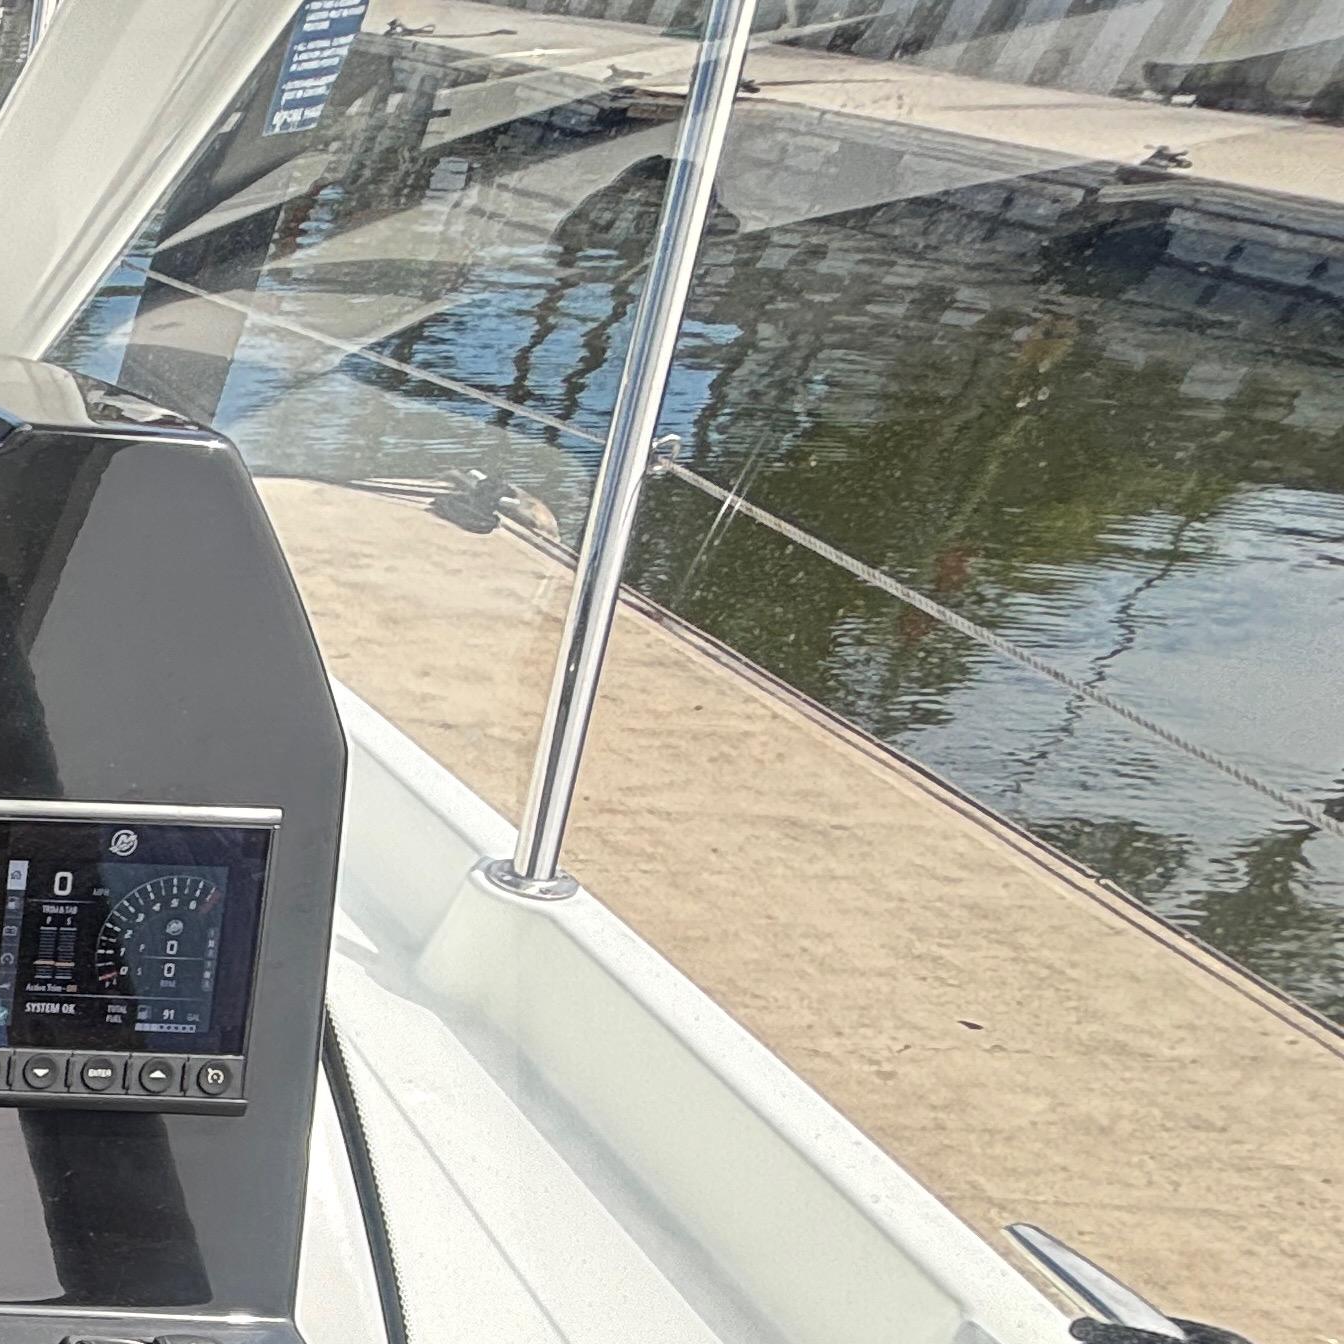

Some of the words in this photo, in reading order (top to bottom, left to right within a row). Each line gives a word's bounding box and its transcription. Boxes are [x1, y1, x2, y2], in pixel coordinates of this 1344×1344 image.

[53, 871, 73, 897] 0
[25, 1002, 59, 1013] SYSTEM
[61, 1003, 76, 1015] OK
[162, 1009, 176, 1020] 91
